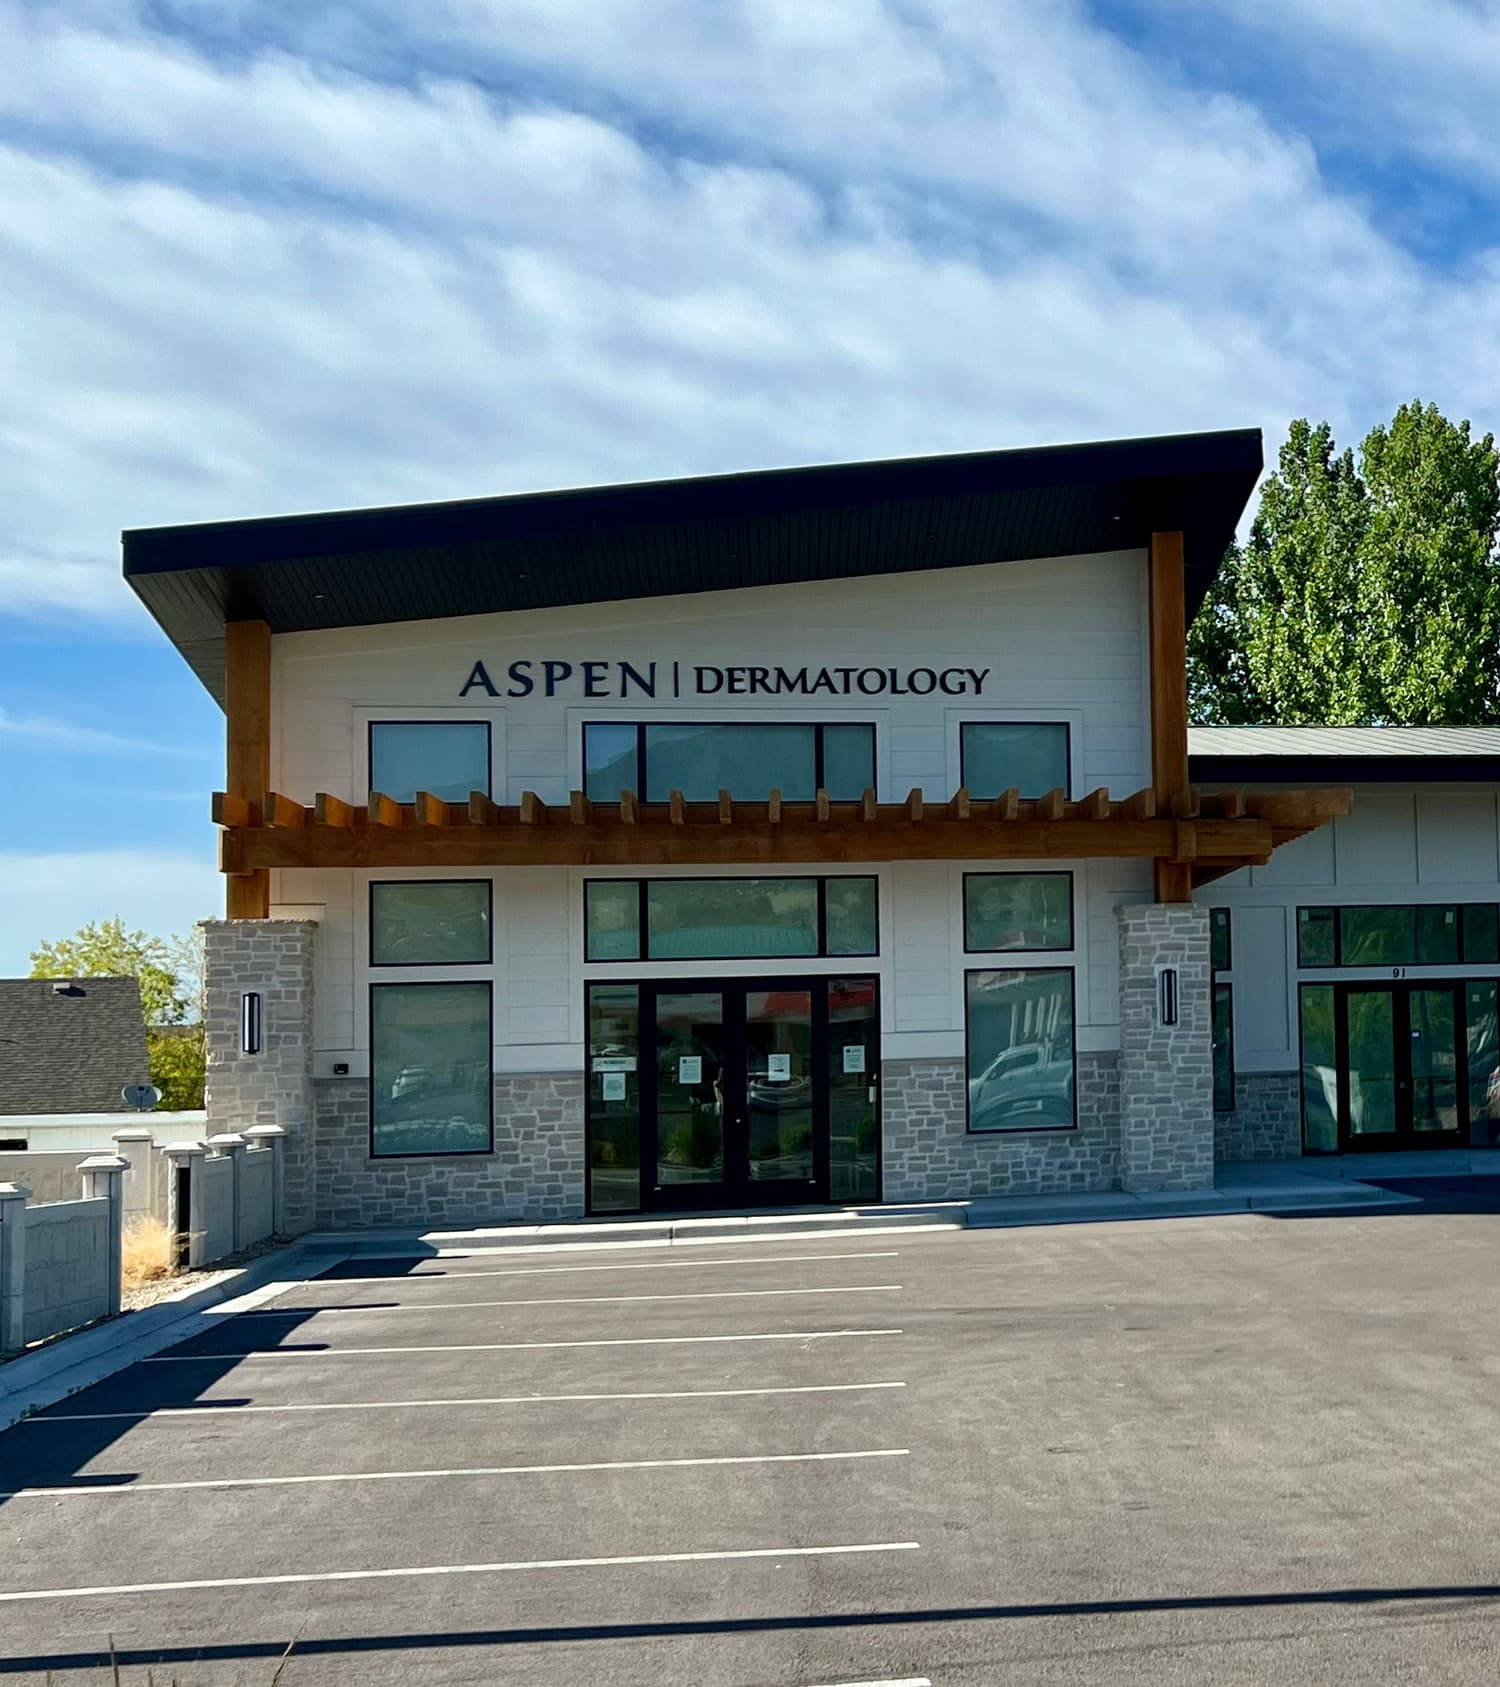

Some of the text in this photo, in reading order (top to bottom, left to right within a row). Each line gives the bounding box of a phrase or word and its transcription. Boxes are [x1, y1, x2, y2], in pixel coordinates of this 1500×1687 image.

[458, 660, 990, 698] ASPEN DERMATOLOGY
[1392, 967, 1406, 978] 91
